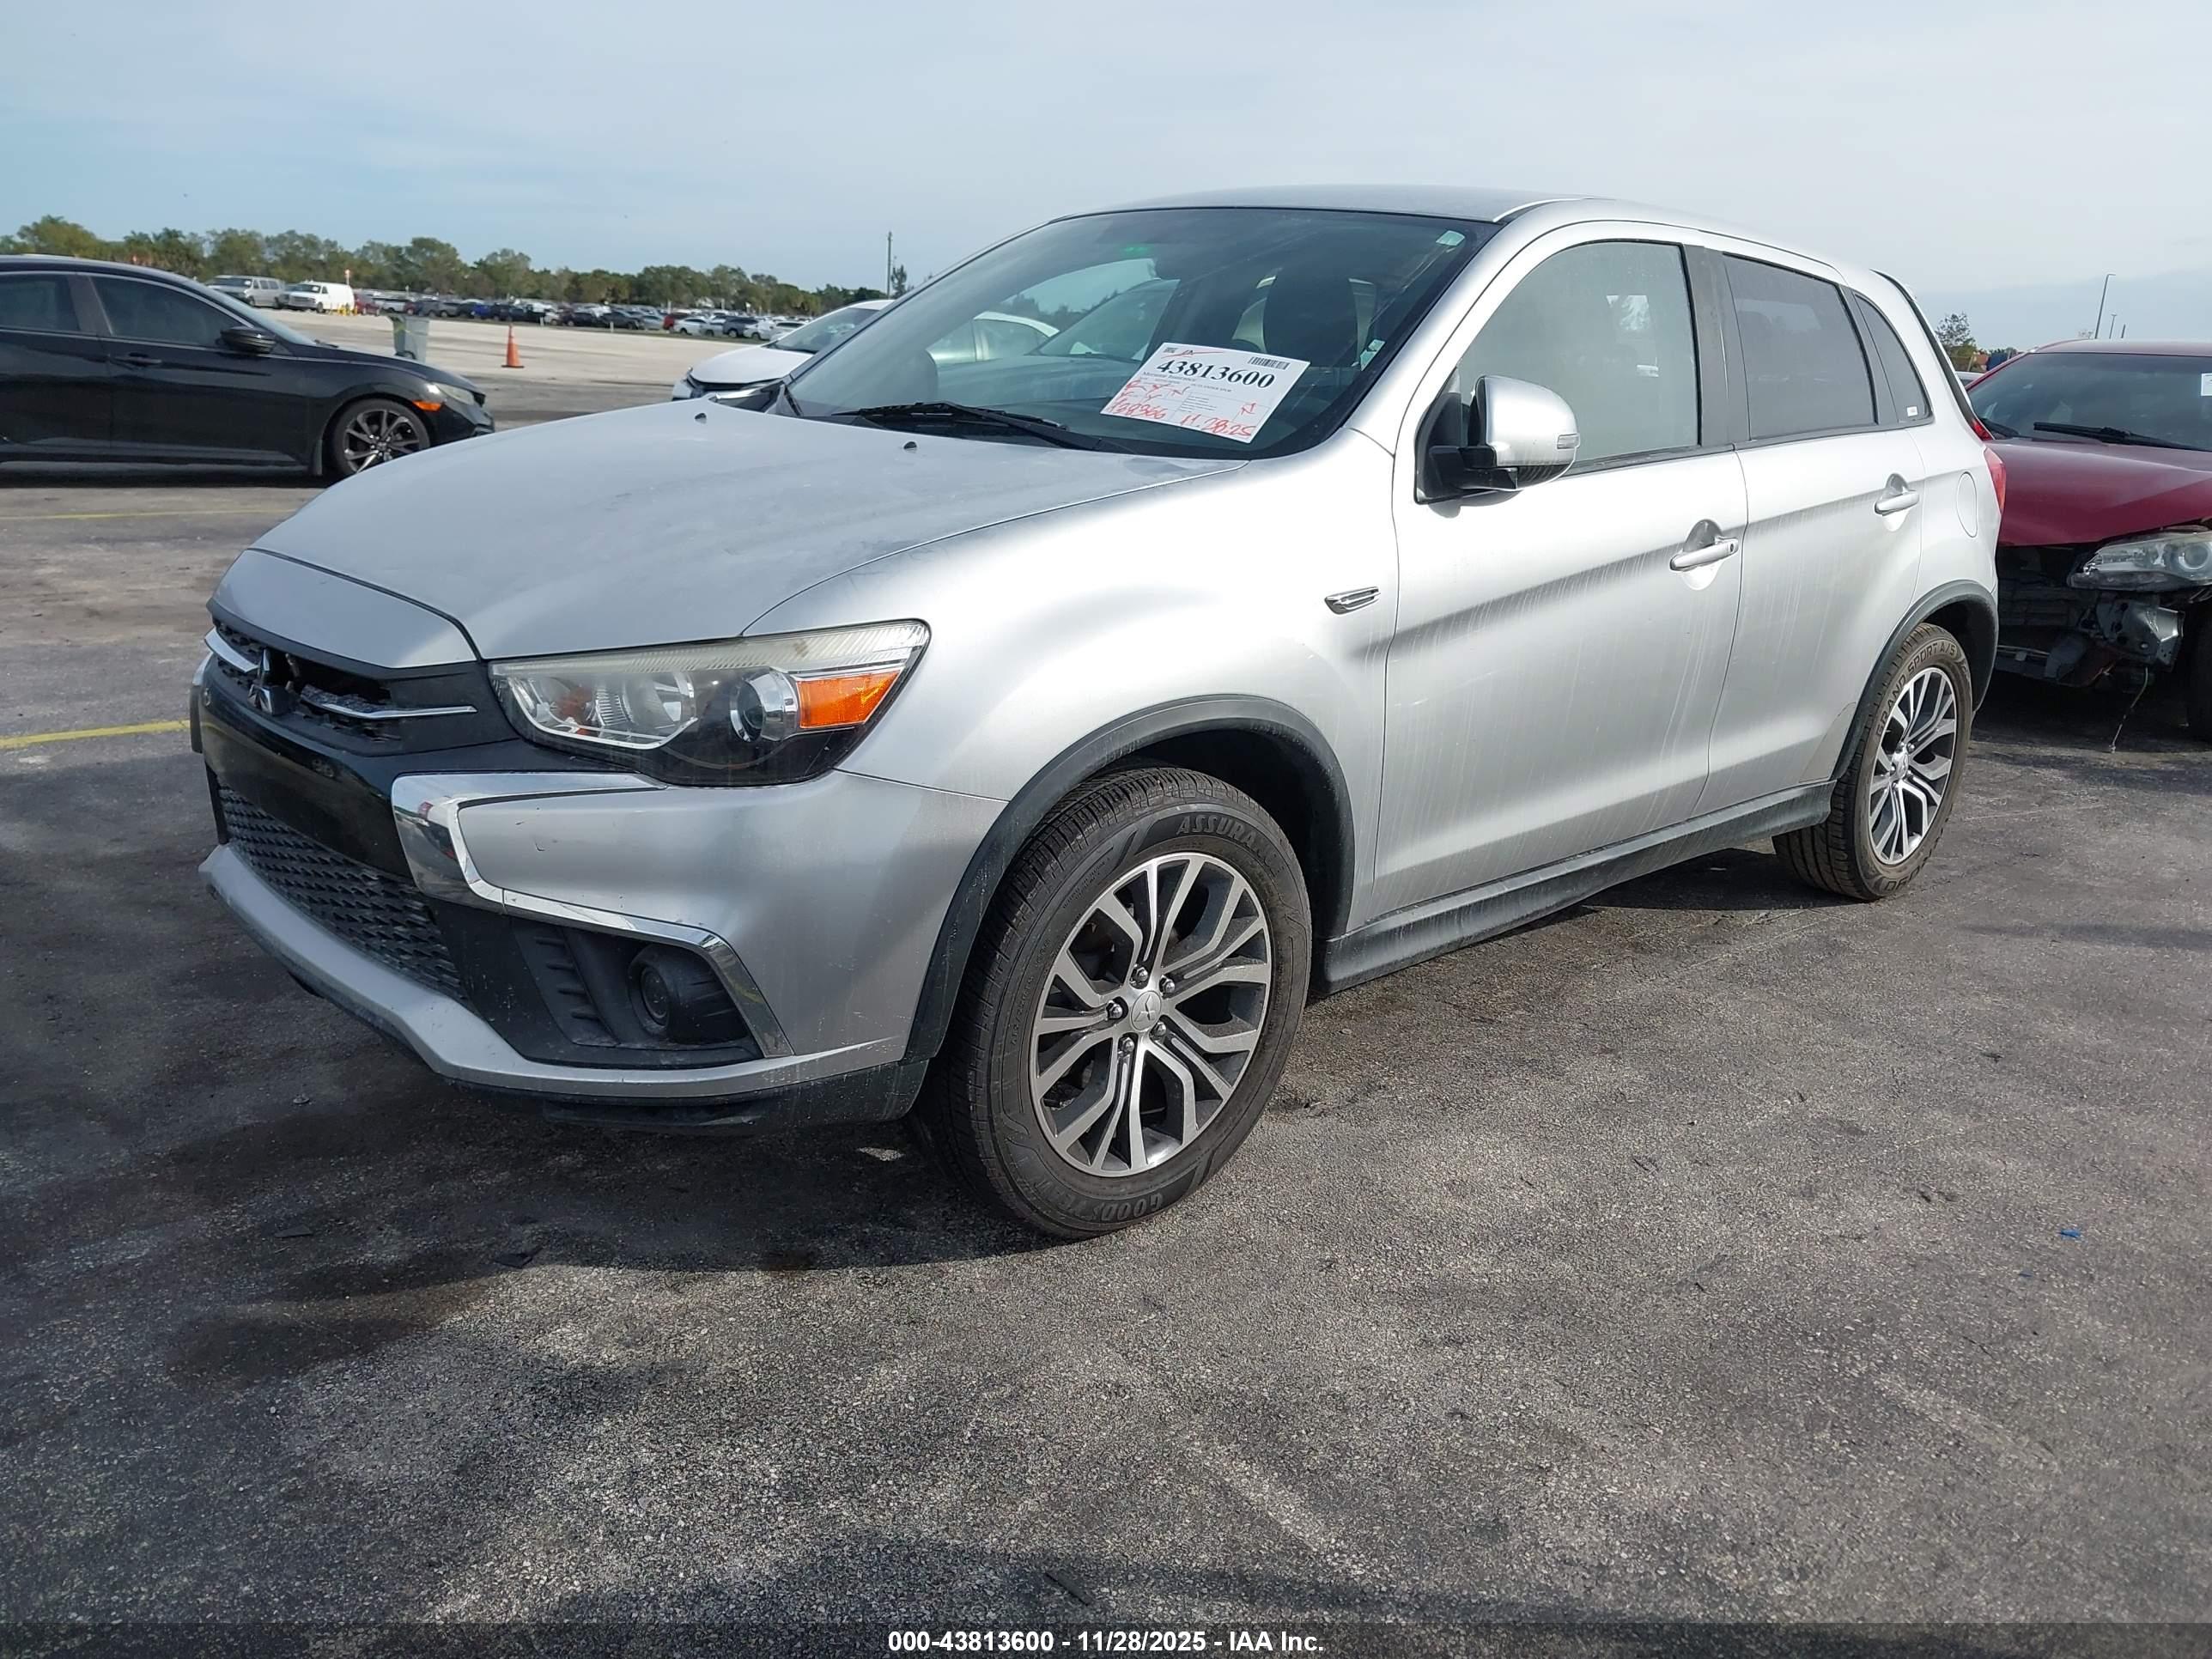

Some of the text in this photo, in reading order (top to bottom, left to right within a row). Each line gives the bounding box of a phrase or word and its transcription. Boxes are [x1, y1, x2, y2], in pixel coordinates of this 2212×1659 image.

[1157, 358, 1275, 389] 43813600
[1875, 673, 1908, 736] GRAND
[1908, 642, 1938, 672] SPORT
[1940, 641, 1957, 656] A/S
[1176, 814, 1285, 878] ASSURACE
